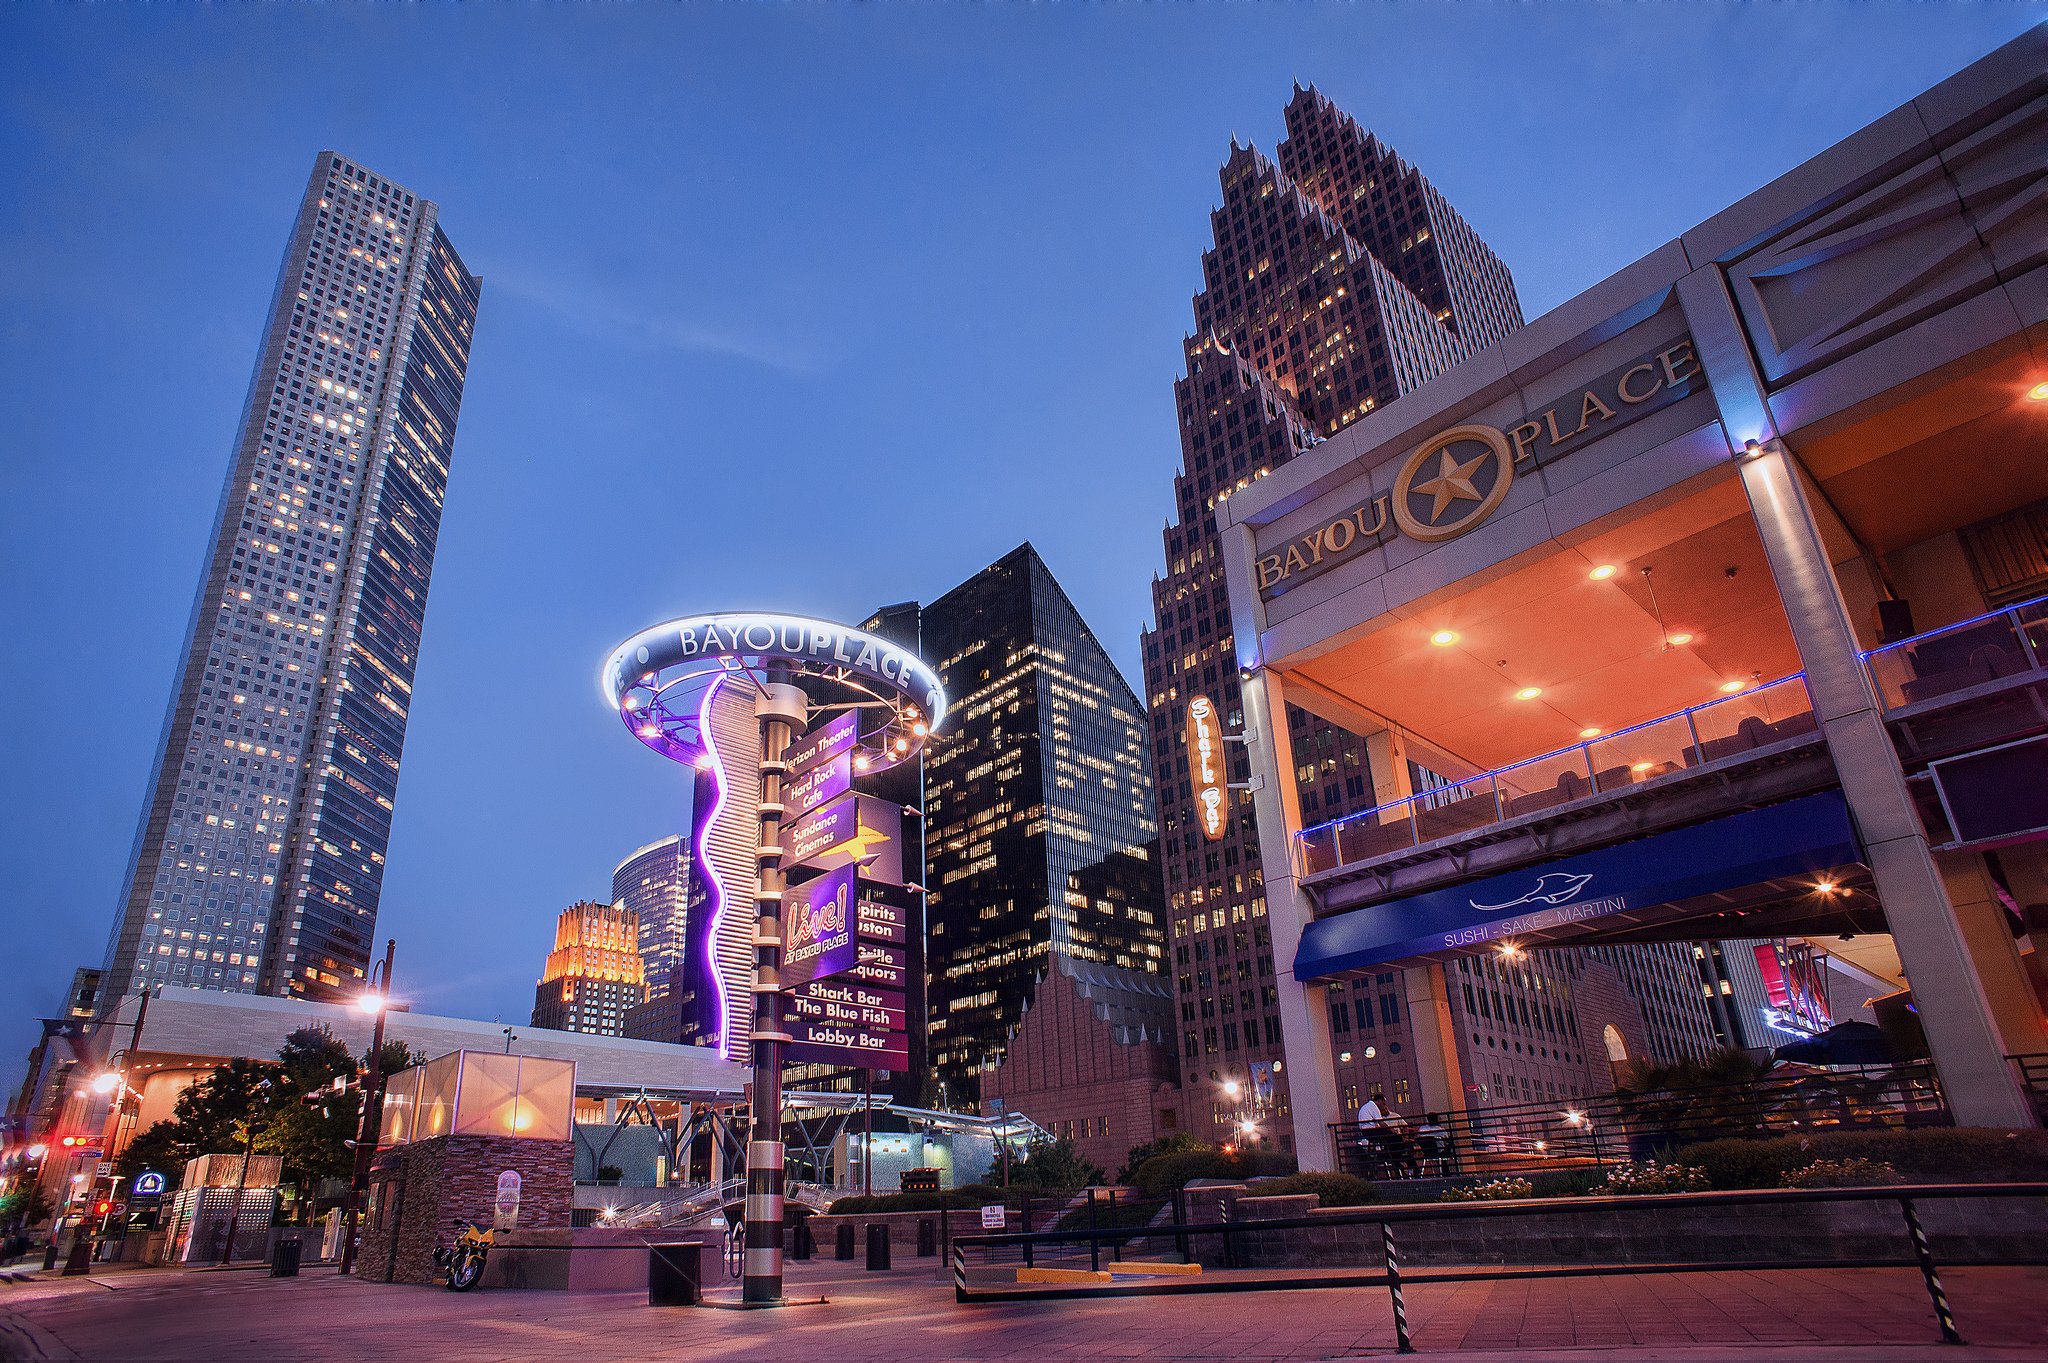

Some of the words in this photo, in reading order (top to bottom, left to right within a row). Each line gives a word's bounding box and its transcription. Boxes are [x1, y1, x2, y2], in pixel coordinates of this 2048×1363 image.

[1255, 496, 1388, 591] BAYOU
[1507, 340, 1702, 464] PLACE
[817, 724, 855, 752] Theater
[1191, 699, 1215, 784] Shark
[790, 775, 813, 801] Hard
[814, 764, 836, 787] Rock
[802, 789, 823, 808] Cafe
[1201, 787, 1221, 834] Bar
[792, 813, 838, 843] Sundance
[794, 831, 835, 857] Cinemas
[786, 883, 848, 953] Live!
[858, 901, 896, 921] pirits
[1444, 927, 1489, 947] SUSHI
[1502, 915, 1544, 935] SAKE
[1557, 896, 1626, 923] MARTINI
[784, 951, 796, 966] AT
[796, 941, 822, 961] BAYOU
[822, 932, 849, 953] PLACE
[809, 983, 853, 1002] Shark
[857, 990, 883, 1006] Bar
[795, 999, 822, 1014] The
[826, 1003, 858, 1020] Blue
[862, 1008, 890, 1025] Fish
[808, 1027, 855, 1049] Lobby
[859, 1033, 886, 1048] Bar
